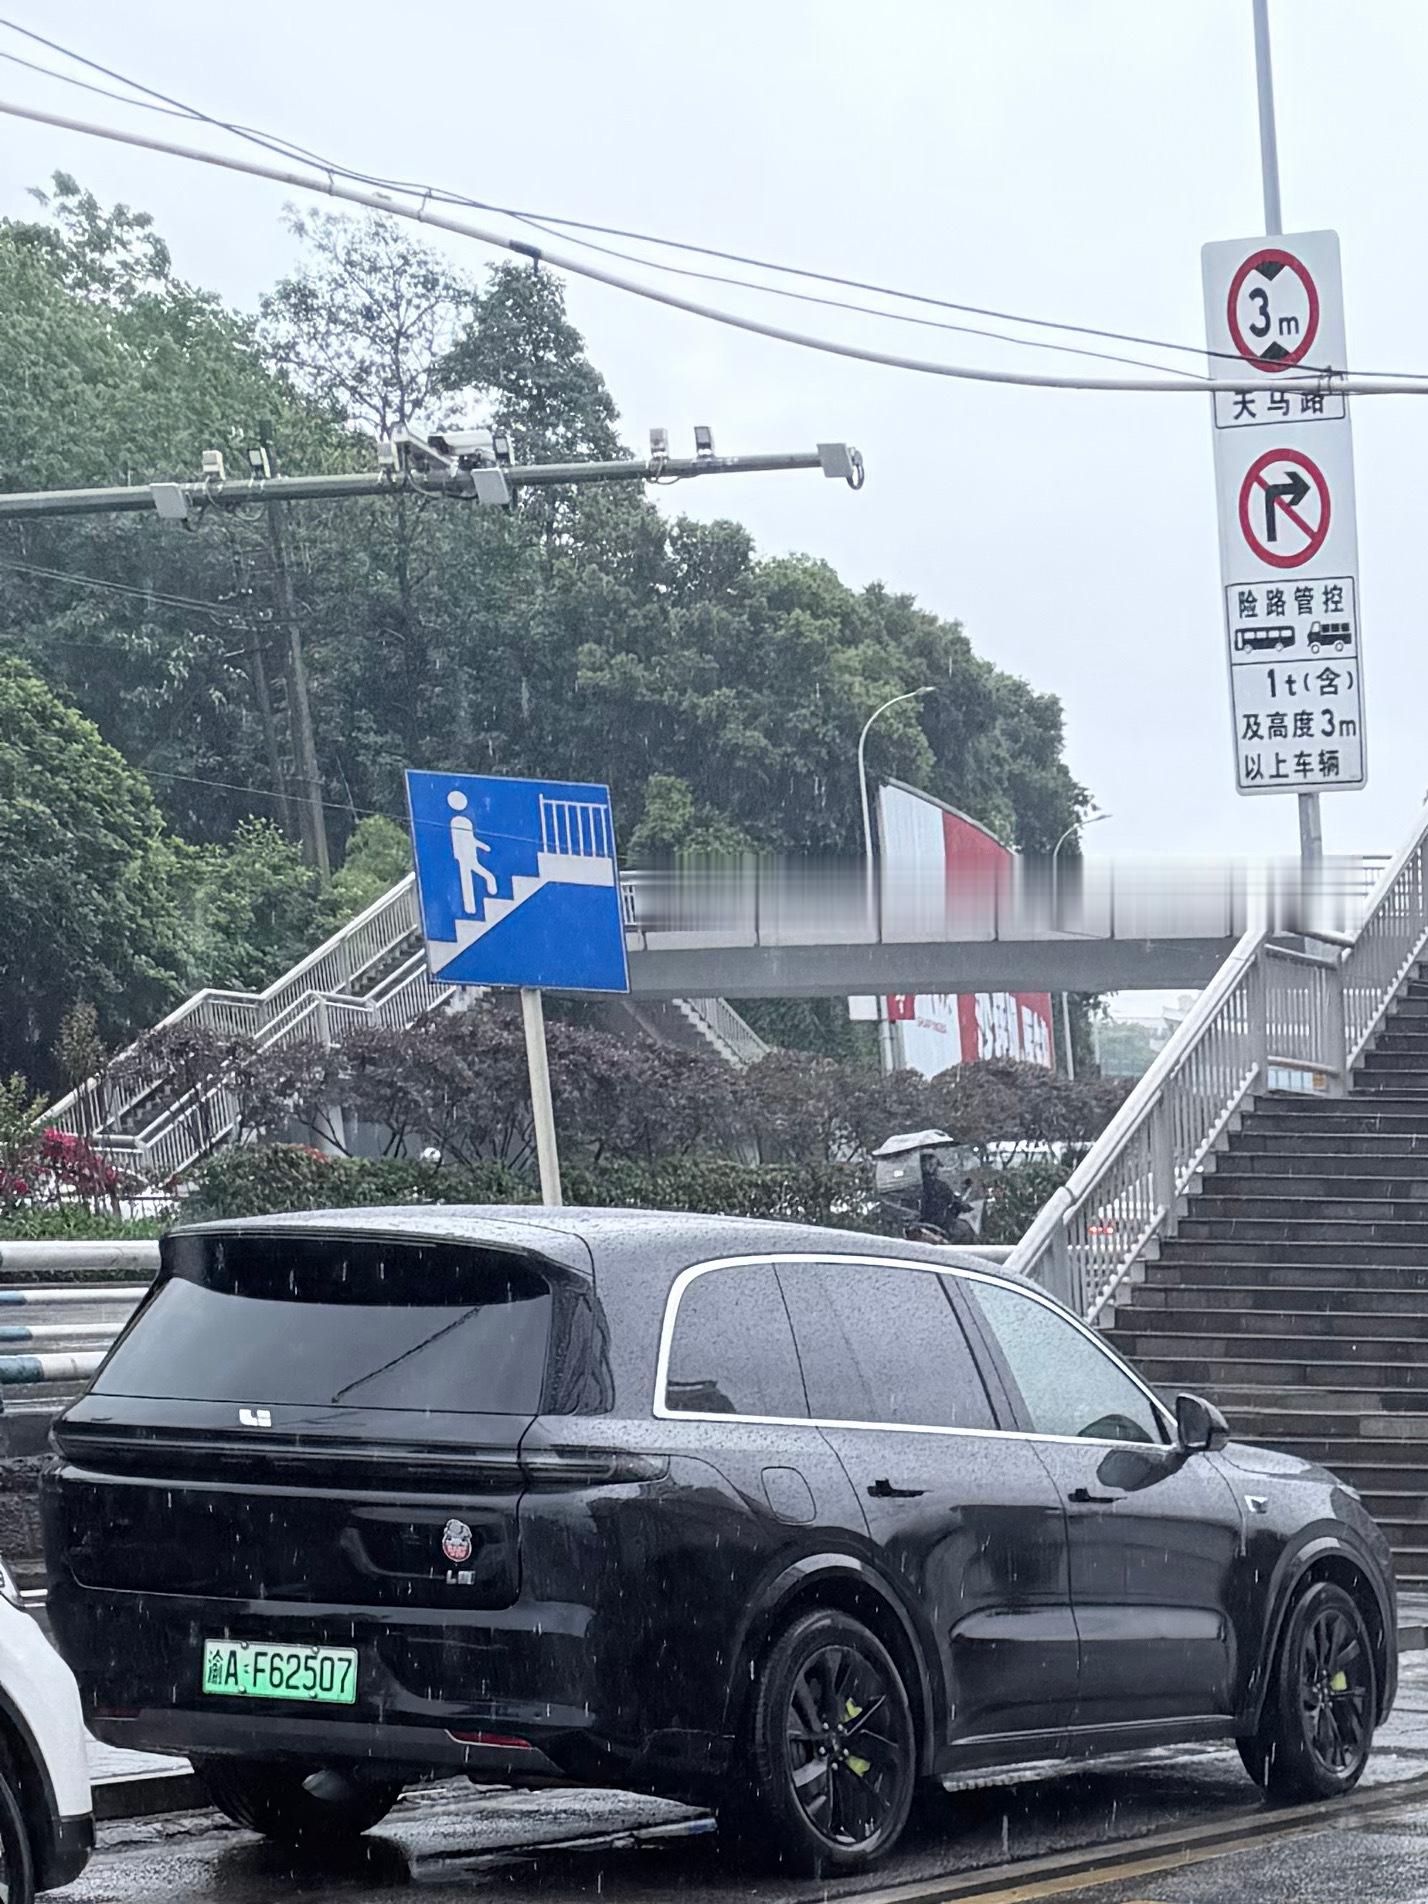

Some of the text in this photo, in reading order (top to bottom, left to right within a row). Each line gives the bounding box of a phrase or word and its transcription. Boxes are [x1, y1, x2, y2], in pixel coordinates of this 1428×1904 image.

[1233, 391, 1325, 419] 天马路
[1239, 584, 1345, 618] 险路管控
[1242, 708, 1356, 741] 及高度3m
[1244, 749, 1339, 781] 以上车辆
